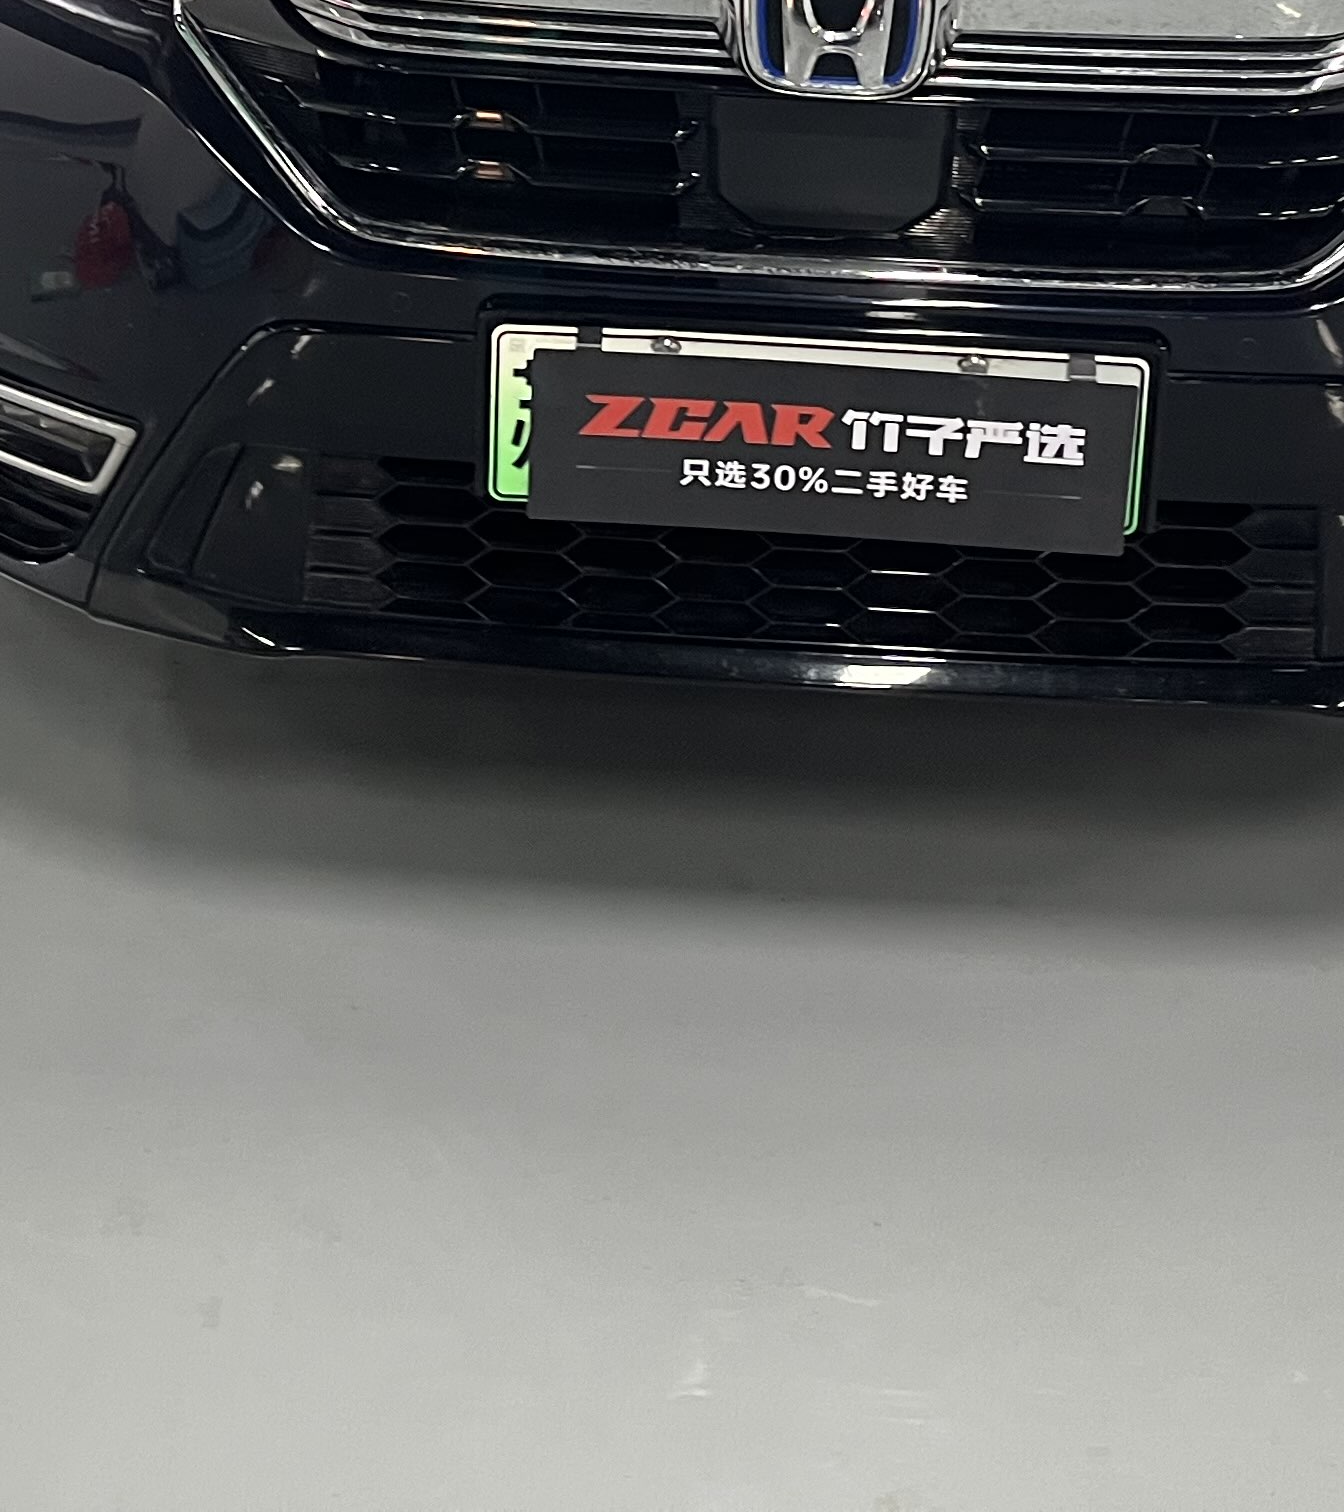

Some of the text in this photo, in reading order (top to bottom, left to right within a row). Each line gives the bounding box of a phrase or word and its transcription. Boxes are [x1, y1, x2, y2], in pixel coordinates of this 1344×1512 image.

[578, 393, 836, 449] ZCAR
[840, 408, 1087, 467] 竹子严选
[678, 458, 970, 504] 只选30%二手好车
